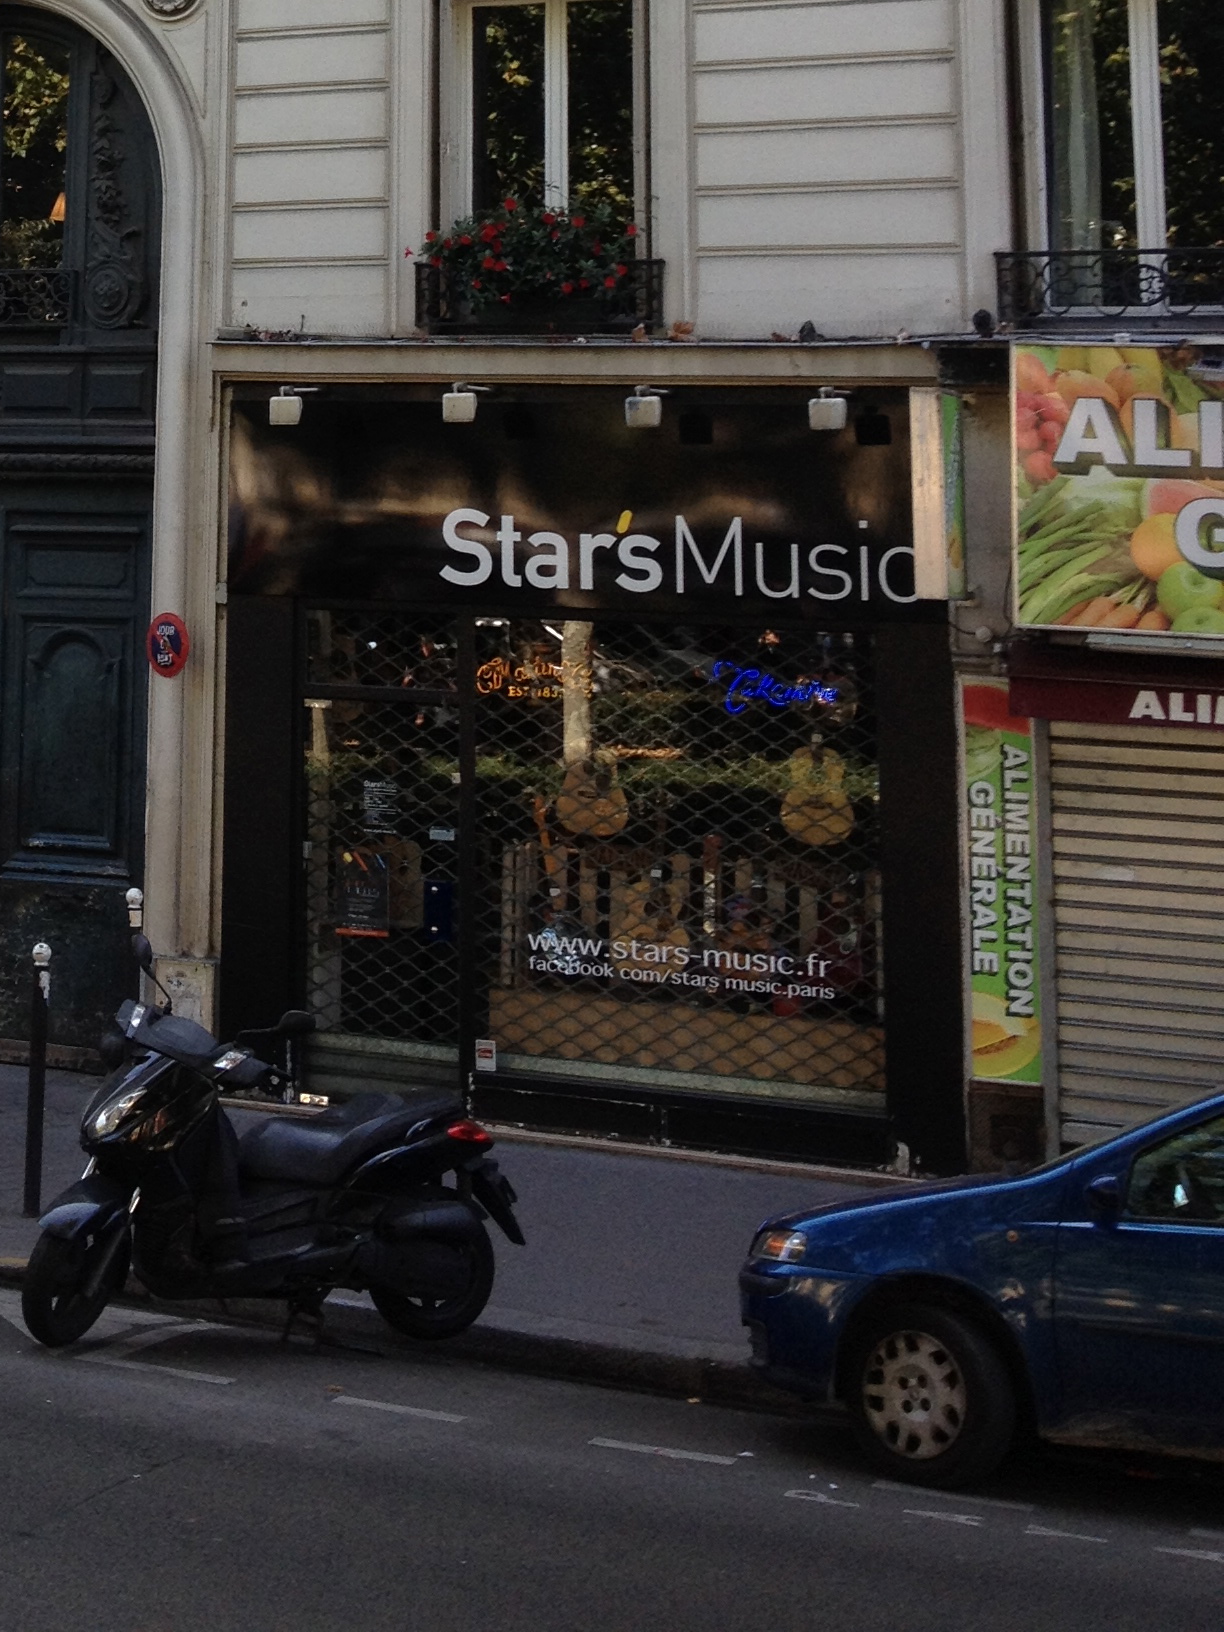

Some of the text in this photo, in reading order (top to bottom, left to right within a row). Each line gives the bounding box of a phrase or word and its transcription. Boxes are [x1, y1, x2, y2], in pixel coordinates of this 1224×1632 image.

[1129, 690, 1224, 725] ALI
[968, 779, 1003, 976] GÉNÉRALE
[1002, 743, 1036, 1017] ALIMENTATION
